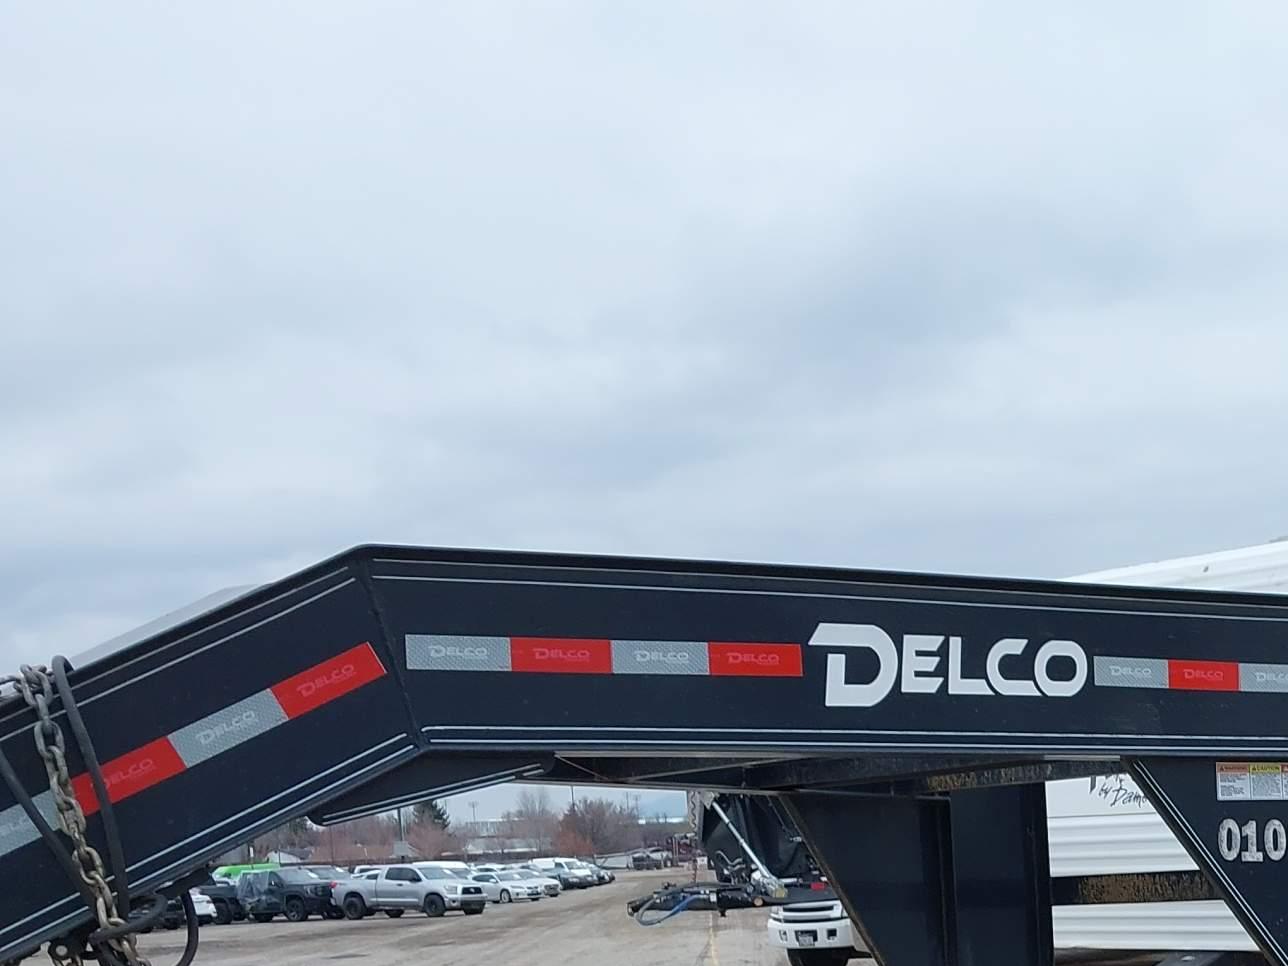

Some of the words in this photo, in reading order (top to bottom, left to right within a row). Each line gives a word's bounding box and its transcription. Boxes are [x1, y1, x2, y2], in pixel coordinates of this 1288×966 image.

[428, 645, 488, 658] DELCO
[532, 647, 591, 660] DELCO
[633, 650, 689, 663] DELCO
[726, 652, 780, 664] DELCO
[808, 622, 1088, 707] DELCO
[1109, 665, 1152, 676] DELCO
[296, 664, 355, 698] DELCO
[1183, 668, 1224, 681] DELCO
[196, 710, 256, 745] DELCO
